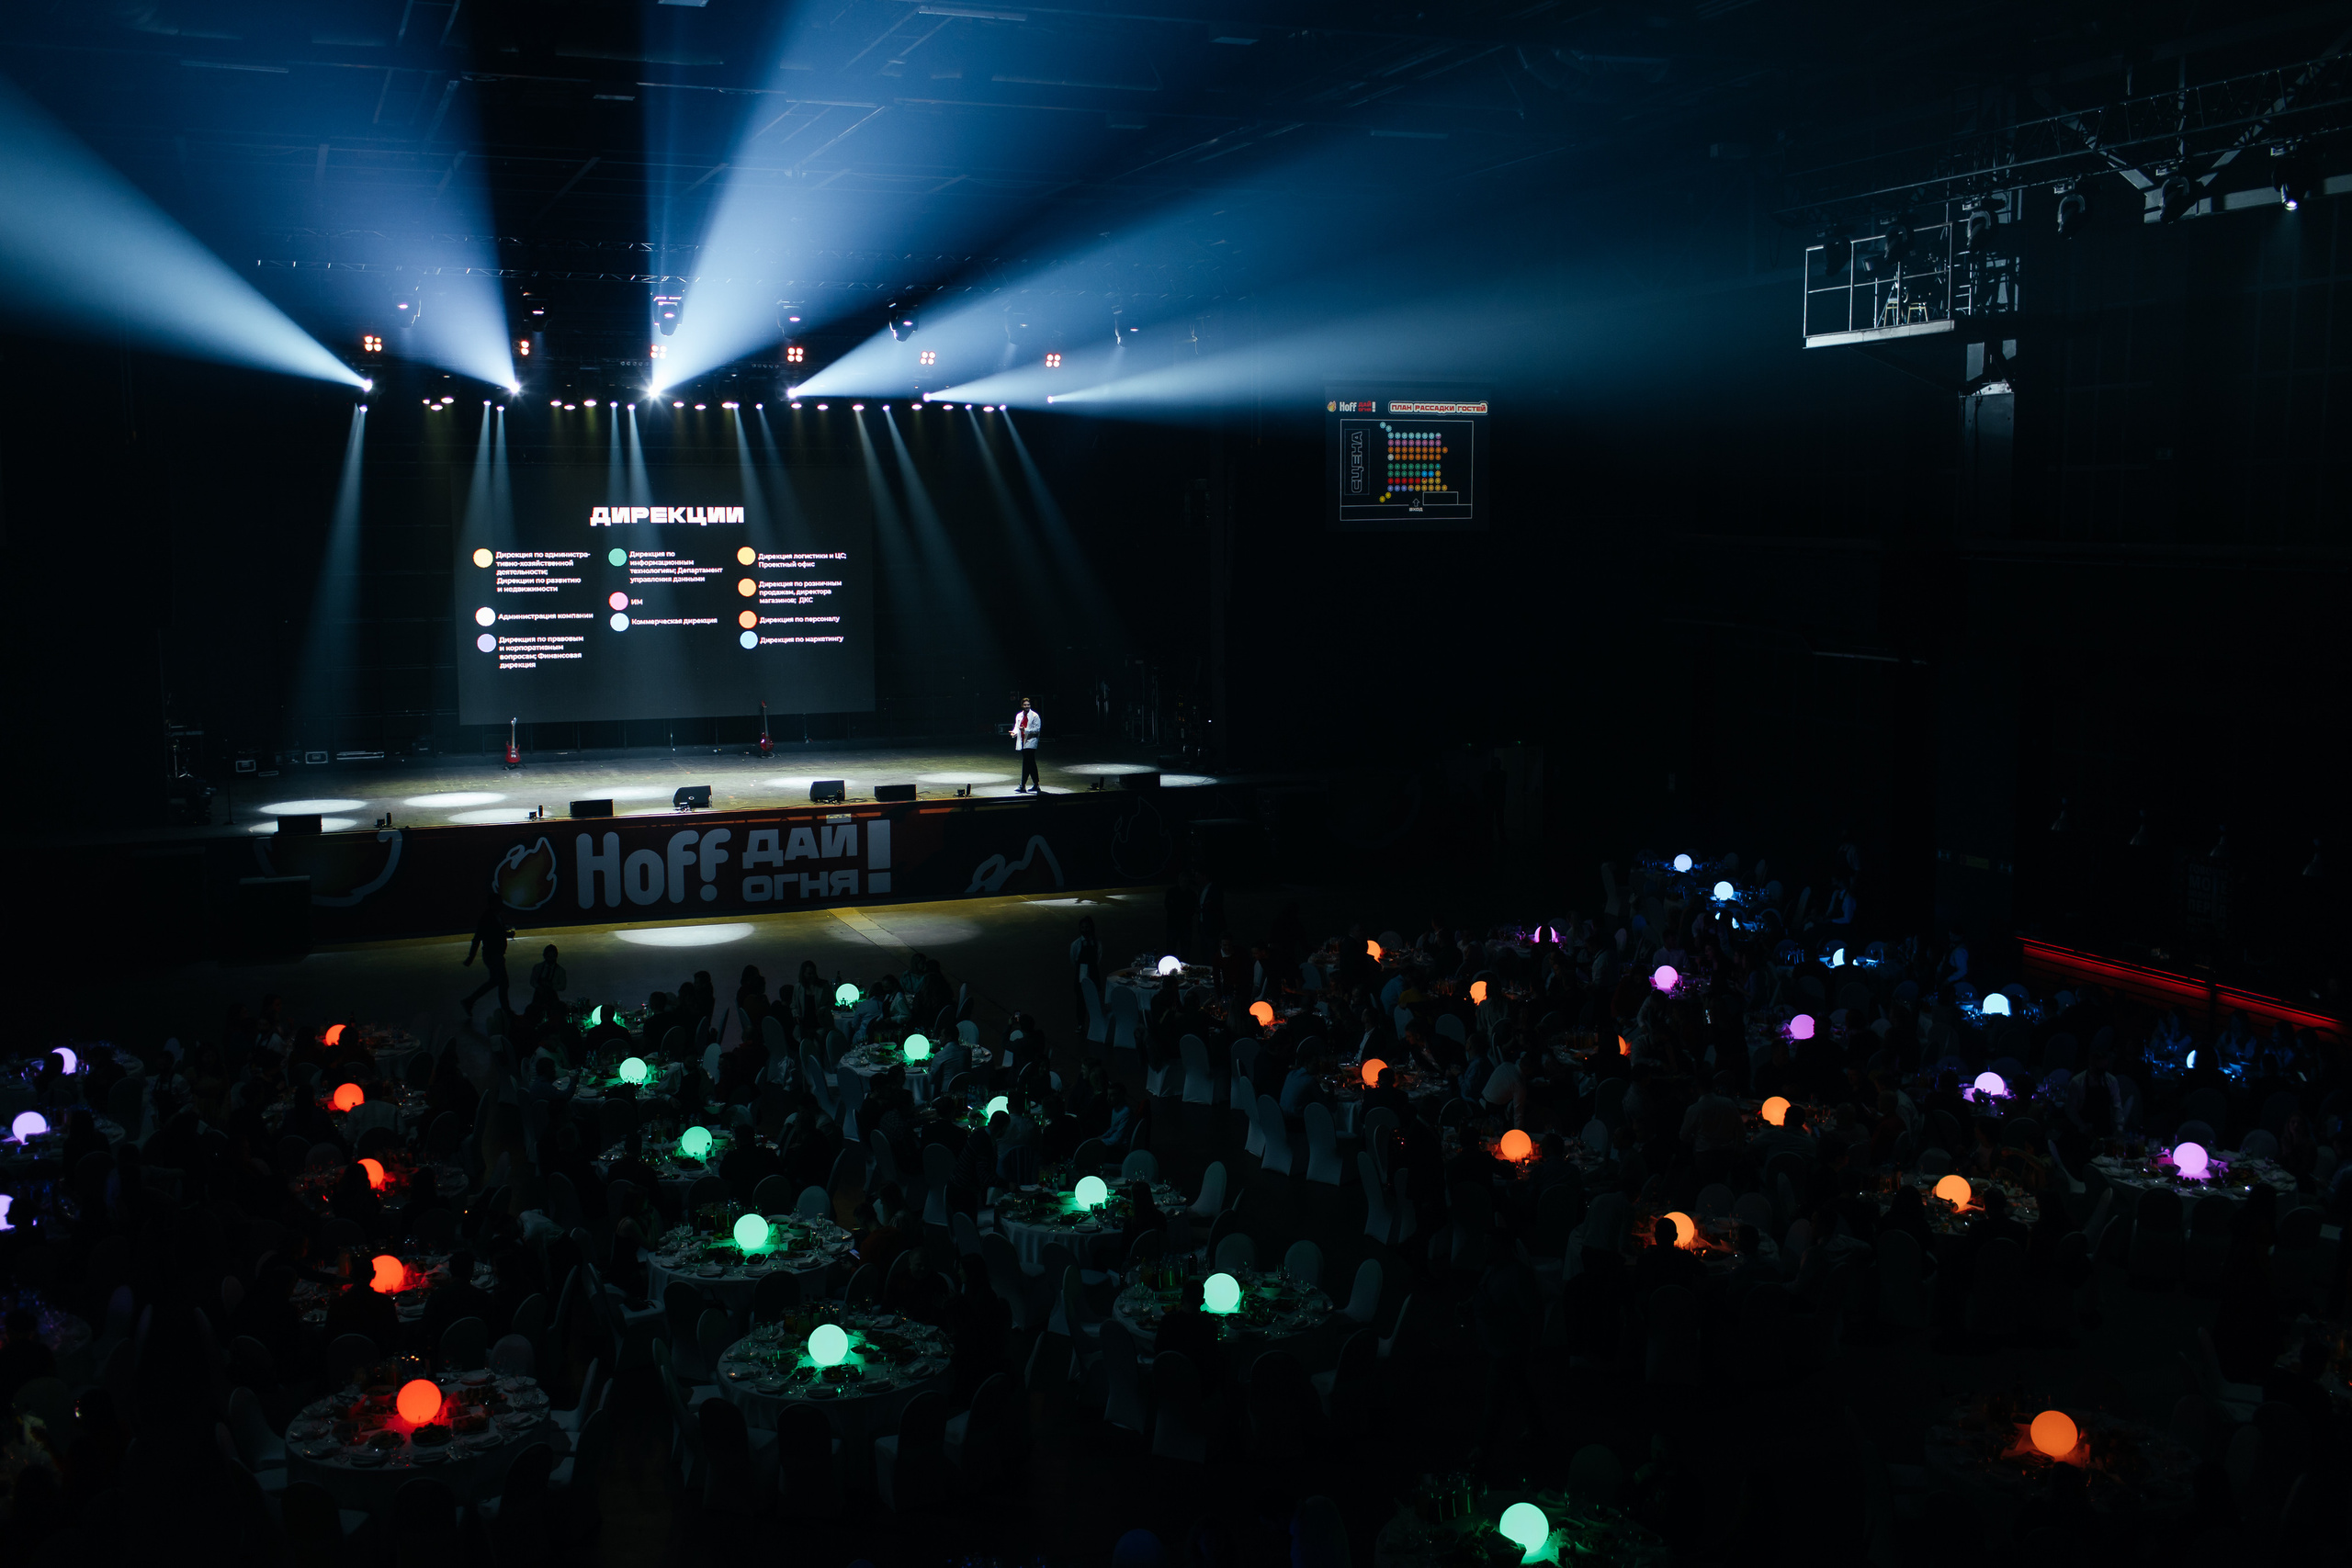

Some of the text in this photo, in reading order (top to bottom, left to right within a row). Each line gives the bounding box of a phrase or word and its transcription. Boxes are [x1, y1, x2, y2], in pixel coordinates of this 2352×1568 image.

[1340, 401, 1357, 412] Hoff
[1457, 403, 1487, 412] ГОСТЕЙ
[1351, 431, 1364, 493] СЦЕНА
[590, 506, 744, 526] ДИРЕКЦИИ
[629, 559, 694, 568] информационным
[742, 813, 858, 869] ДАЙ
[576, 828, 731, 909] Hoff
